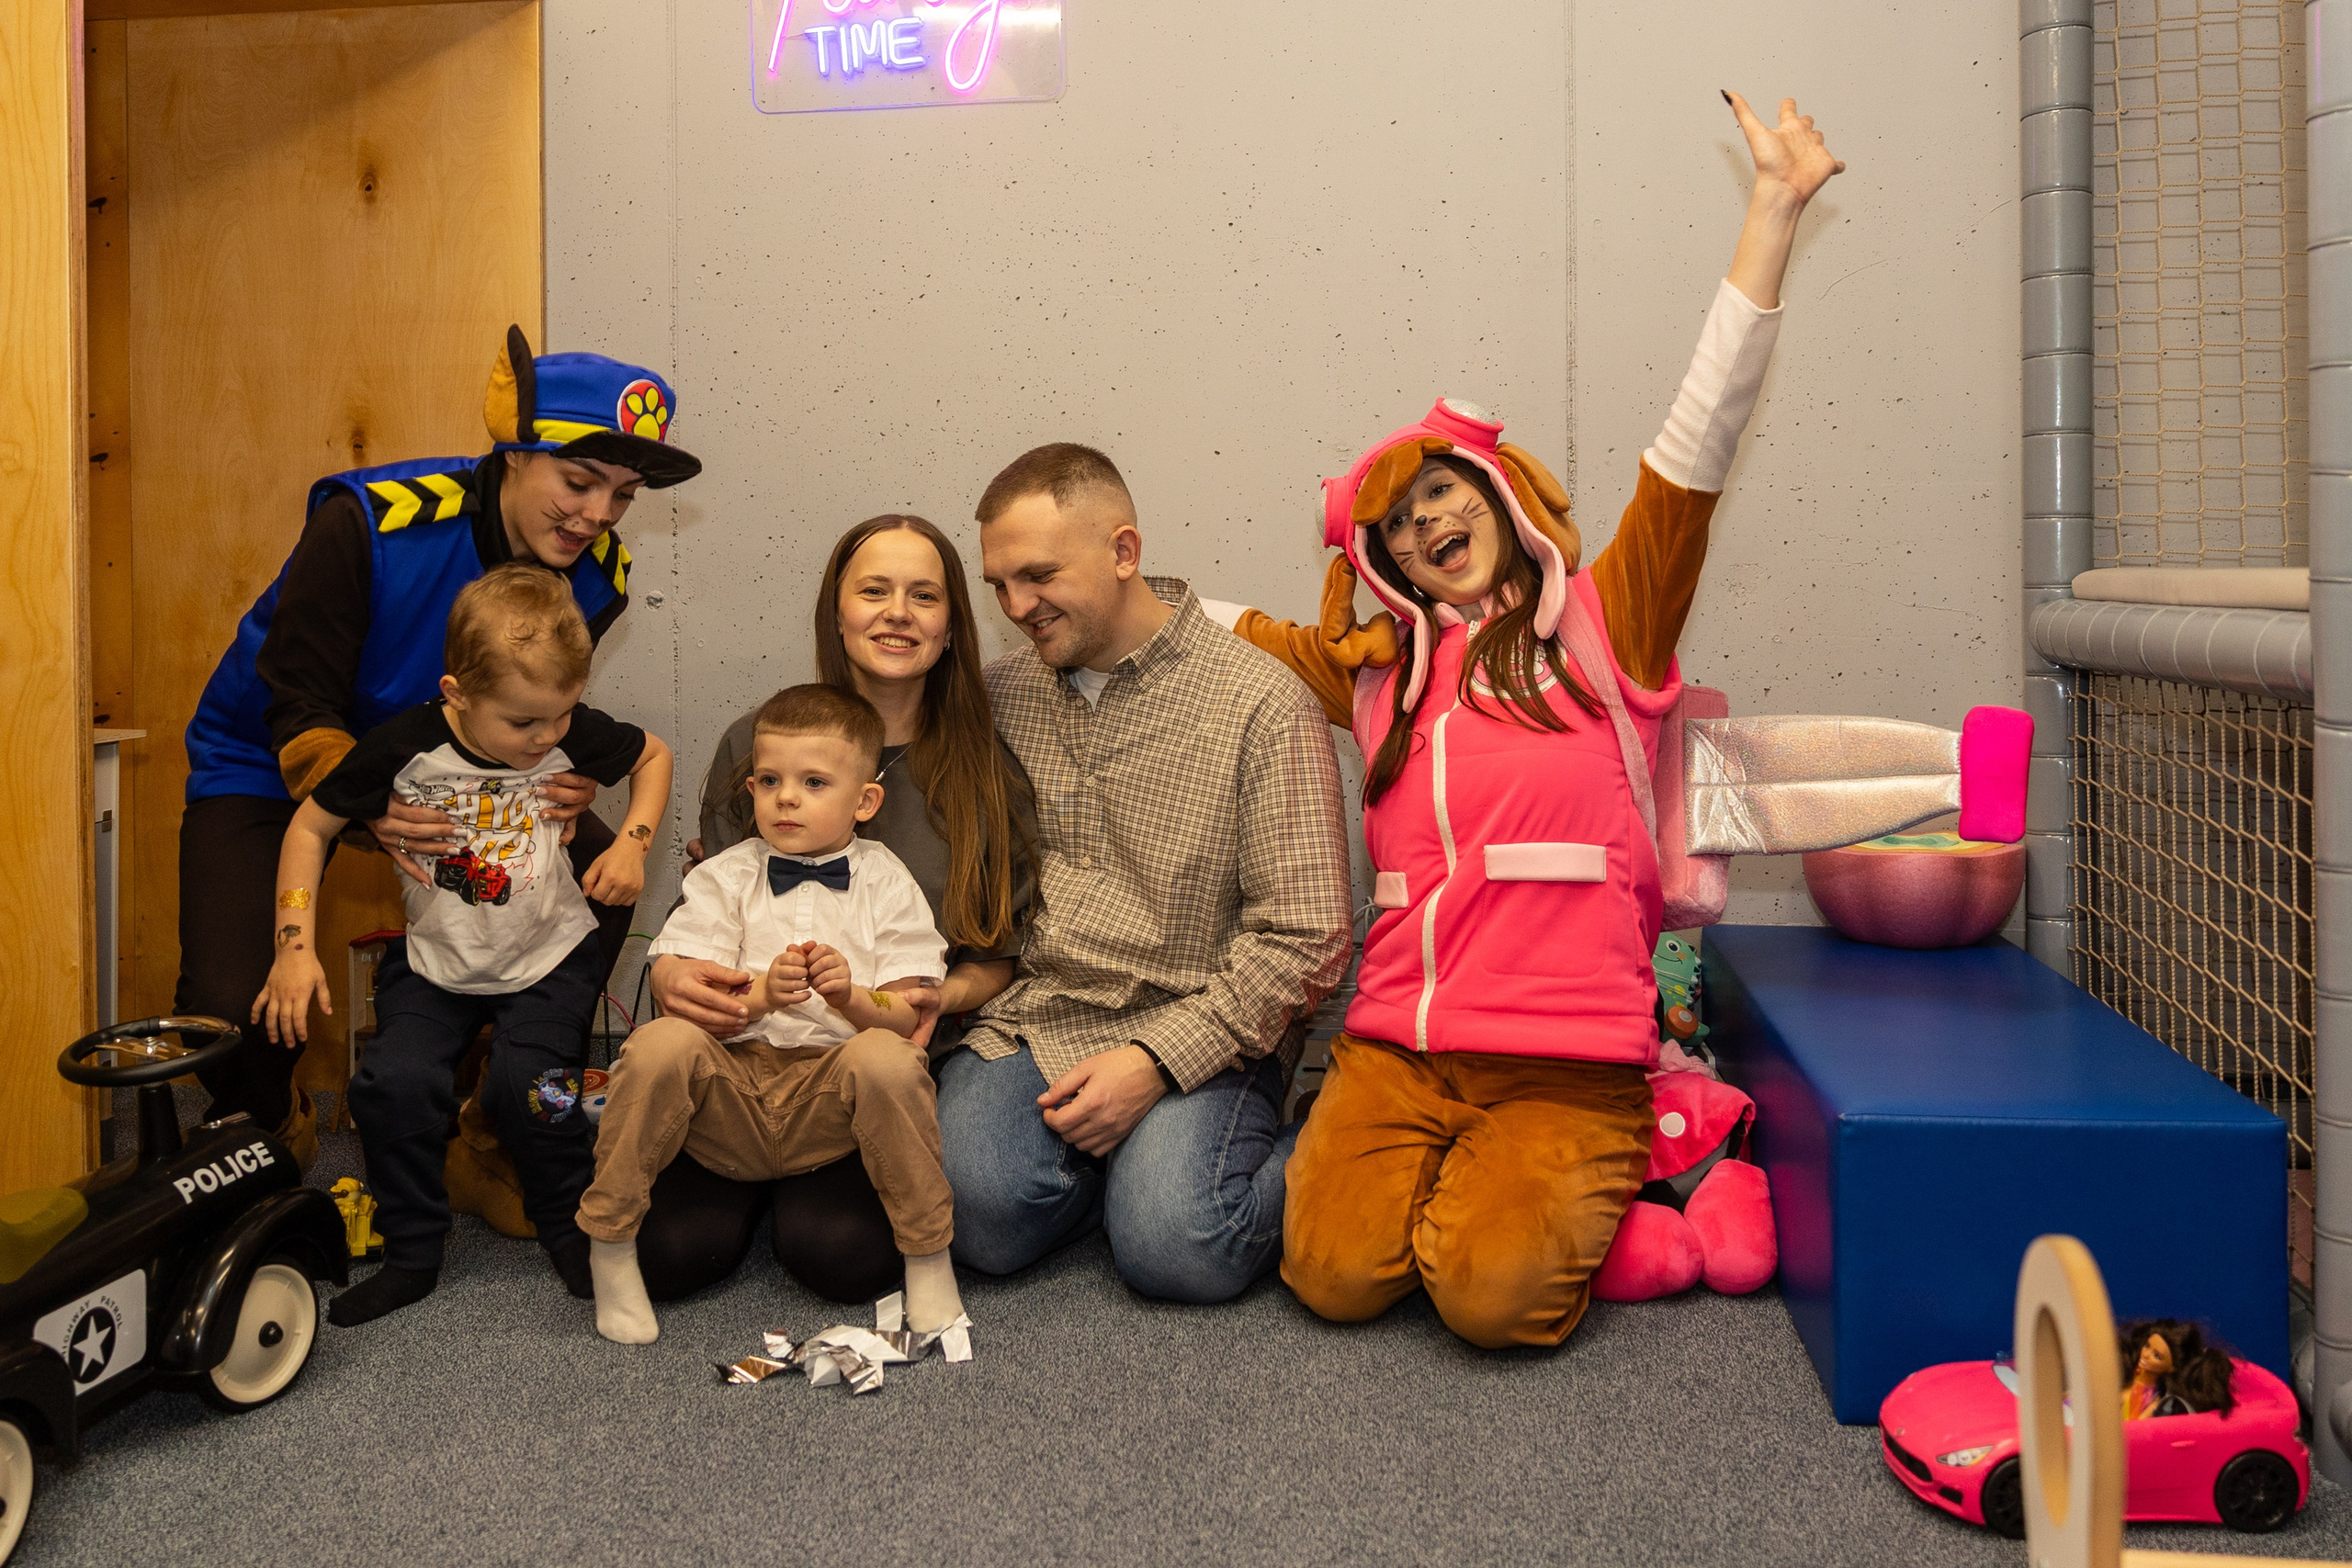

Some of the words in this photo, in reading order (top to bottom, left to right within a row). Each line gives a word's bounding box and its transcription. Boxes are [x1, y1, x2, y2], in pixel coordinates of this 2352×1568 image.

[805, 17, 926, 76] TIME
[173, 1141, 275, 1204] POLICE
[100, 1295, 123, 1329] PATROL
